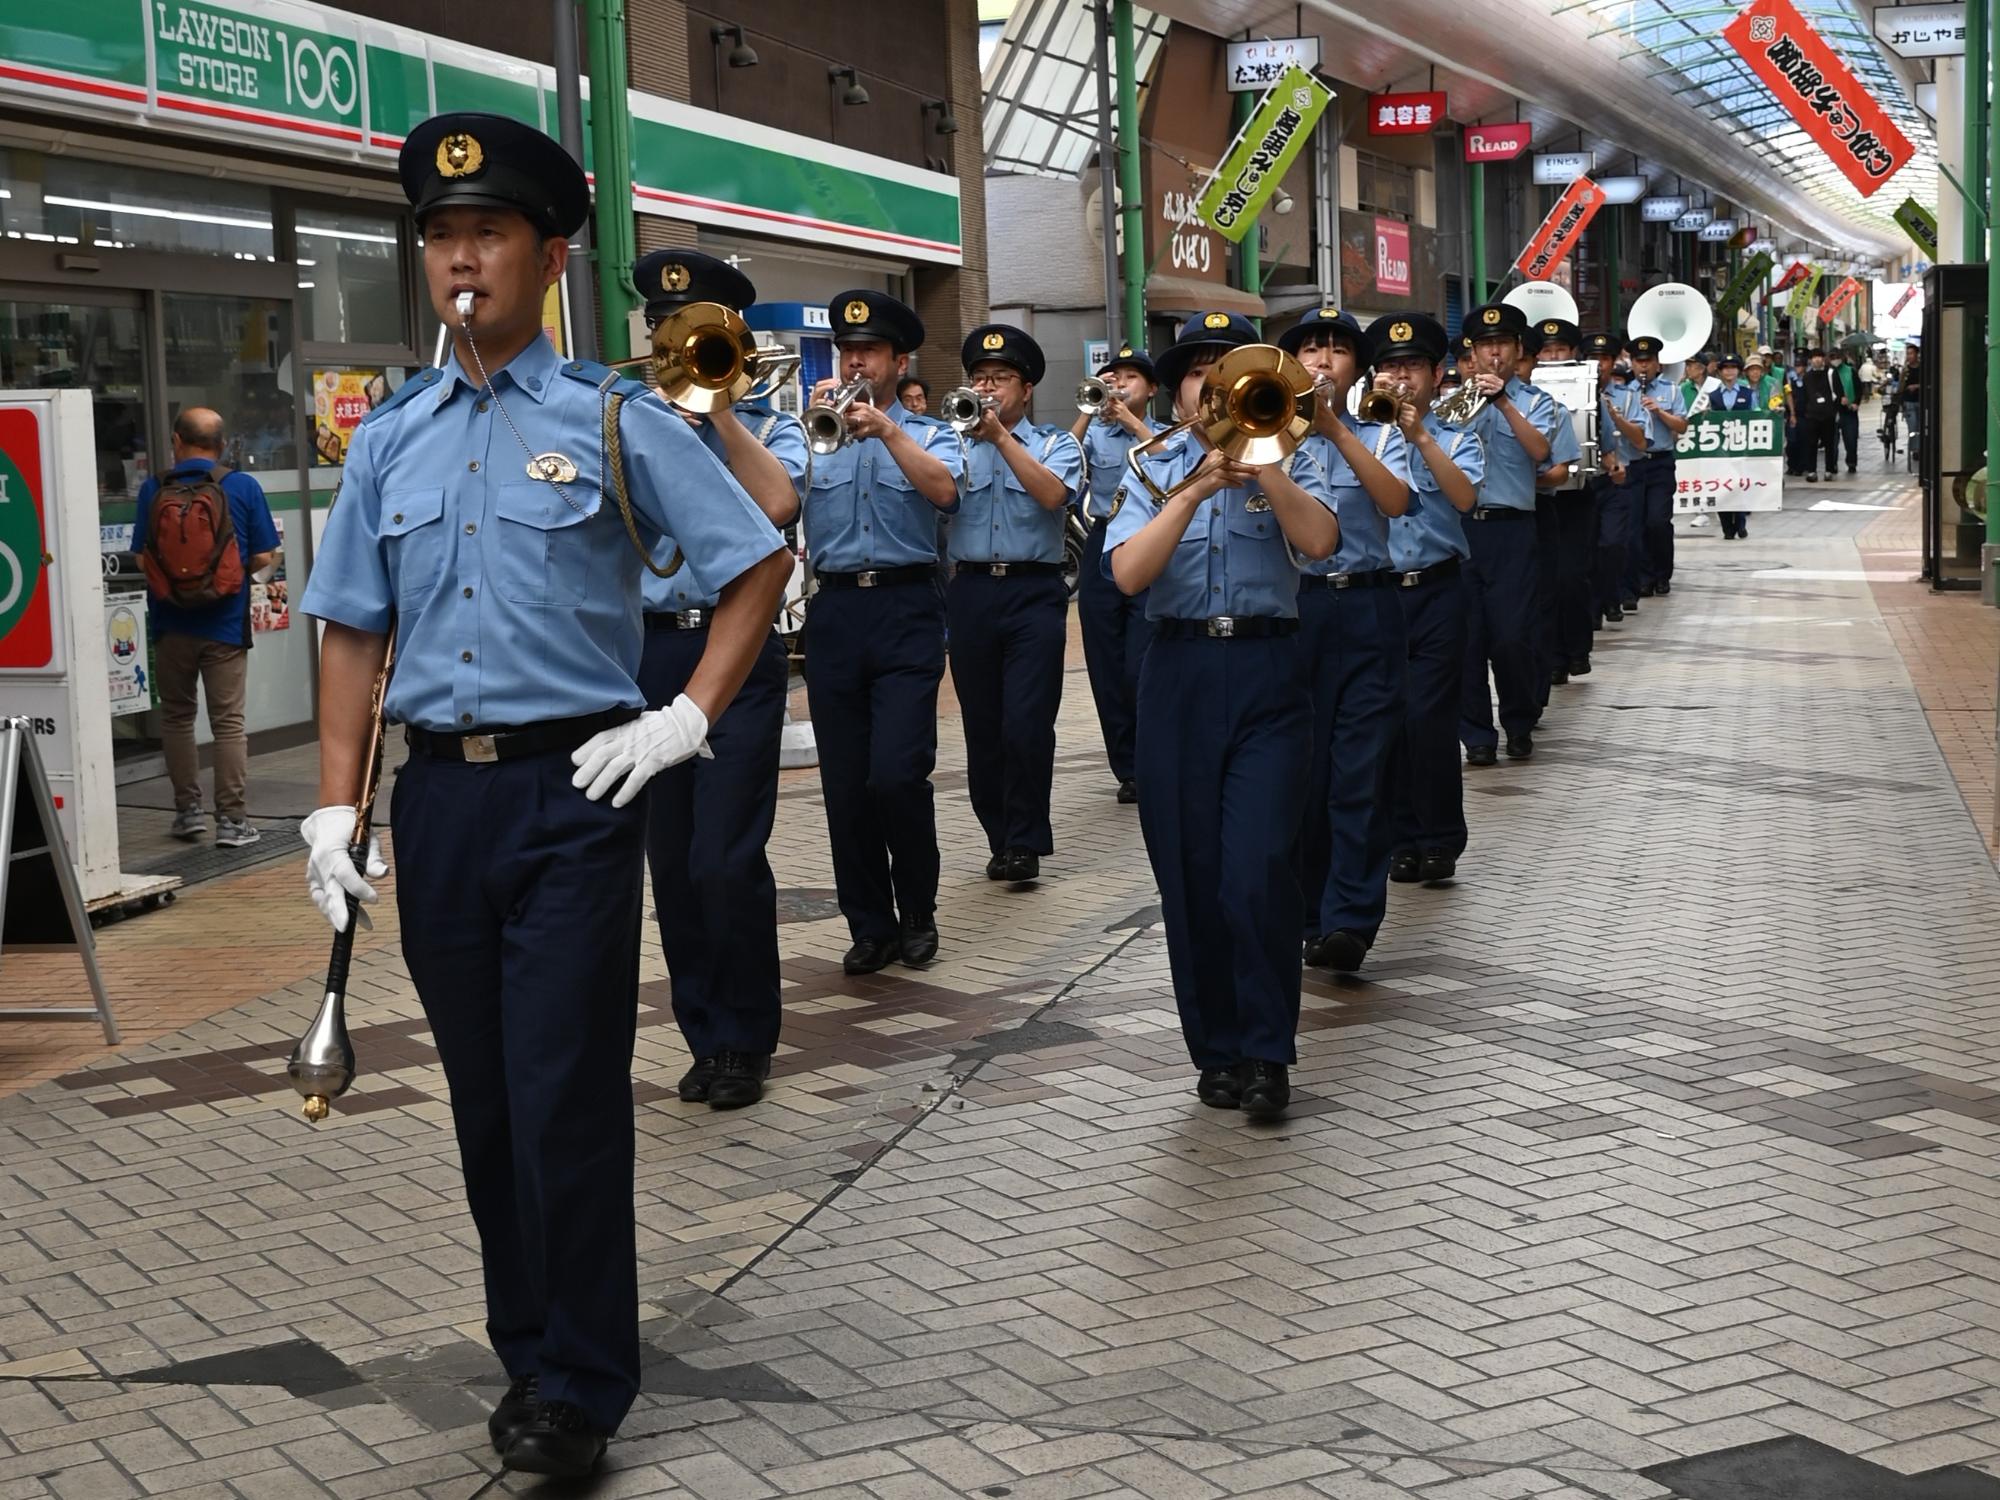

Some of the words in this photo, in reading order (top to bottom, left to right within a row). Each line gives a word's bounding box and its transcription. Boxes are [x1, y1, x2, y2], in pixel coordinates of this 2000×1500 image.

[157, 2, 272, 62] LAWSON
[178, 52, 259, 99] STORE
[275, 31, 357, 115] 100
[1378, 104, 1432, 126] 美容室
[1470, 135, 1518, 153] READD
[1172, 232, 1210, 273] ひばり
[1676, 419, 1773, 453] まち池田
